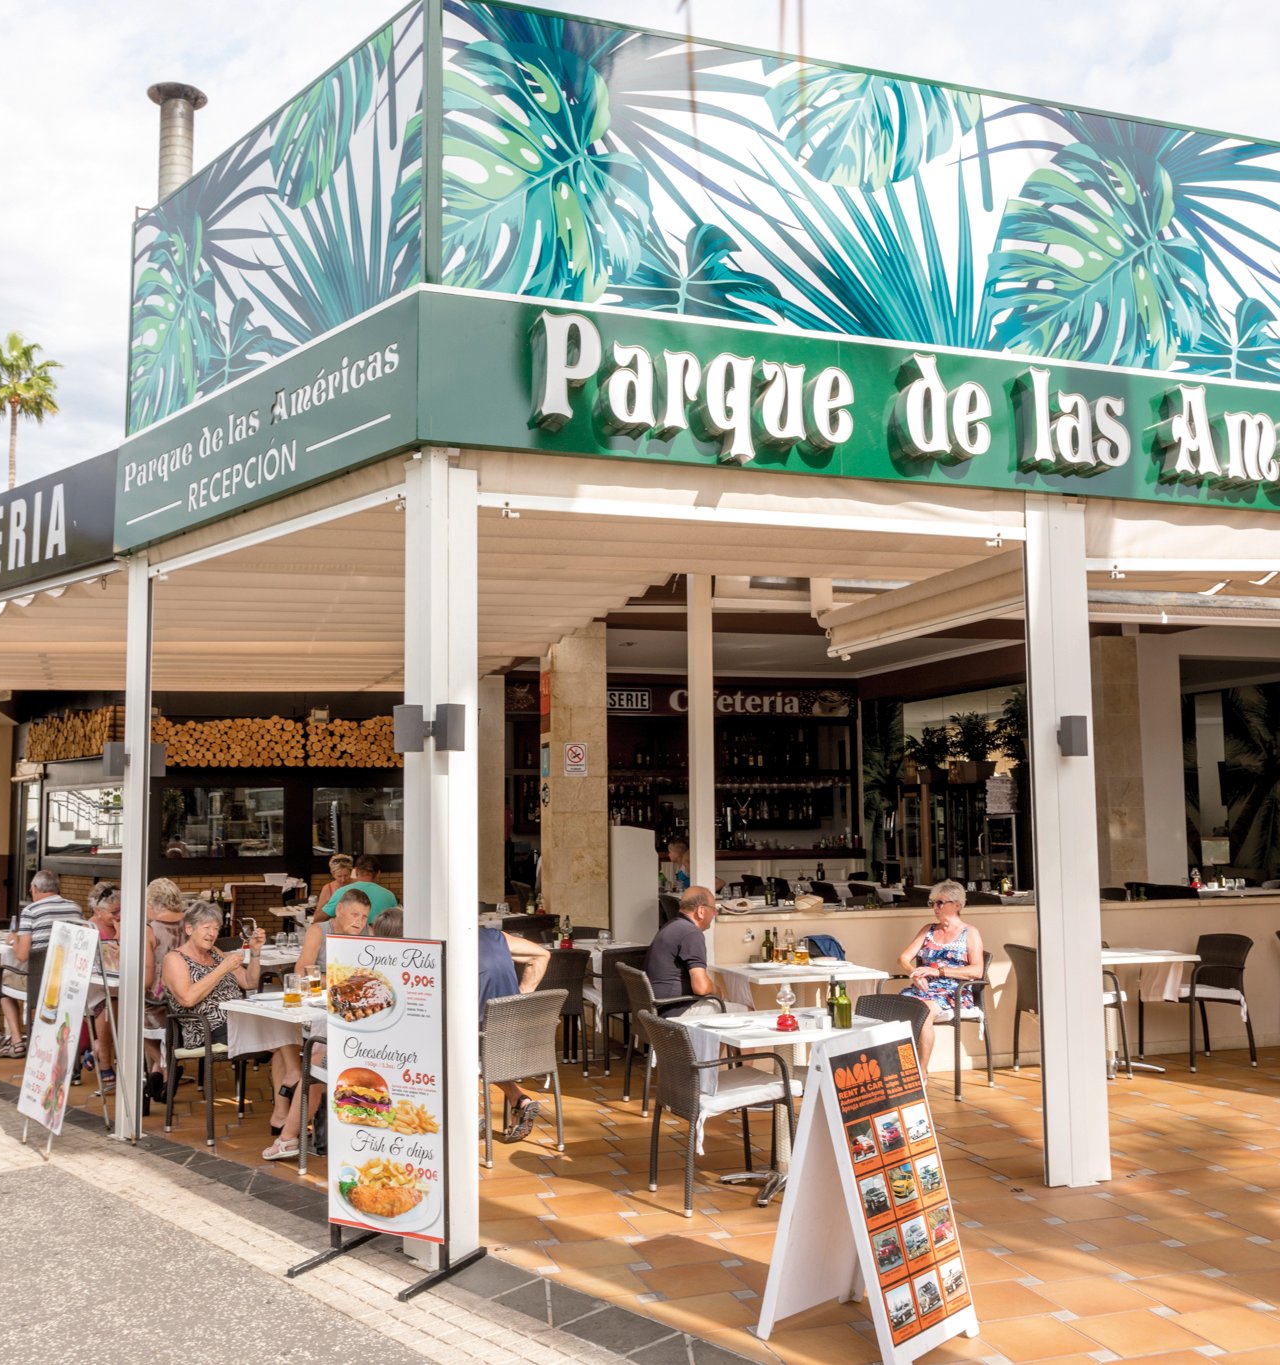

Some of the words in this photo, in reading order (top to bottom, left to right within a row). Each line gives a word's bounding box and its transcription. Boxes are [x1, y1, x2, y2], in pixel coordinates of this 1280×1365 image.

[539, 309, 855, 461] Parque
[906, 352, 992, 457] de
[1027, 365, 1131, 468] las
[123, 441, 193, 493] Parque
[198, 426, 224, 459] de
[228, 408, 260, 446] las
[270, 341, 400, 425] Américas
[187, 437, 297, 513] RECEPCIÓN
[608, 692, 648, 708] SERIE
[668, 689, 800, 713] Ceteria
[357, 944, 398, 971] Spare
[401, 948, 436, 969] Ribs
[401, 971, 435, 988] 9,90€
[343, 1036, 418, 1070] Cheeseburger
[402, 1068, 436, 1087] 6,50€
[838, 1087, 859, 1100] RENT
[860, 1086, 867, 1094] A
[866, 1080, 883, 1091] CAR
[351, 1129, 386, 1153] Fish
[389, 1137, 404, 1156] &
[406, 1142, 434, 1165] chips
[404, 1163, 438, 1182] 9,90€
